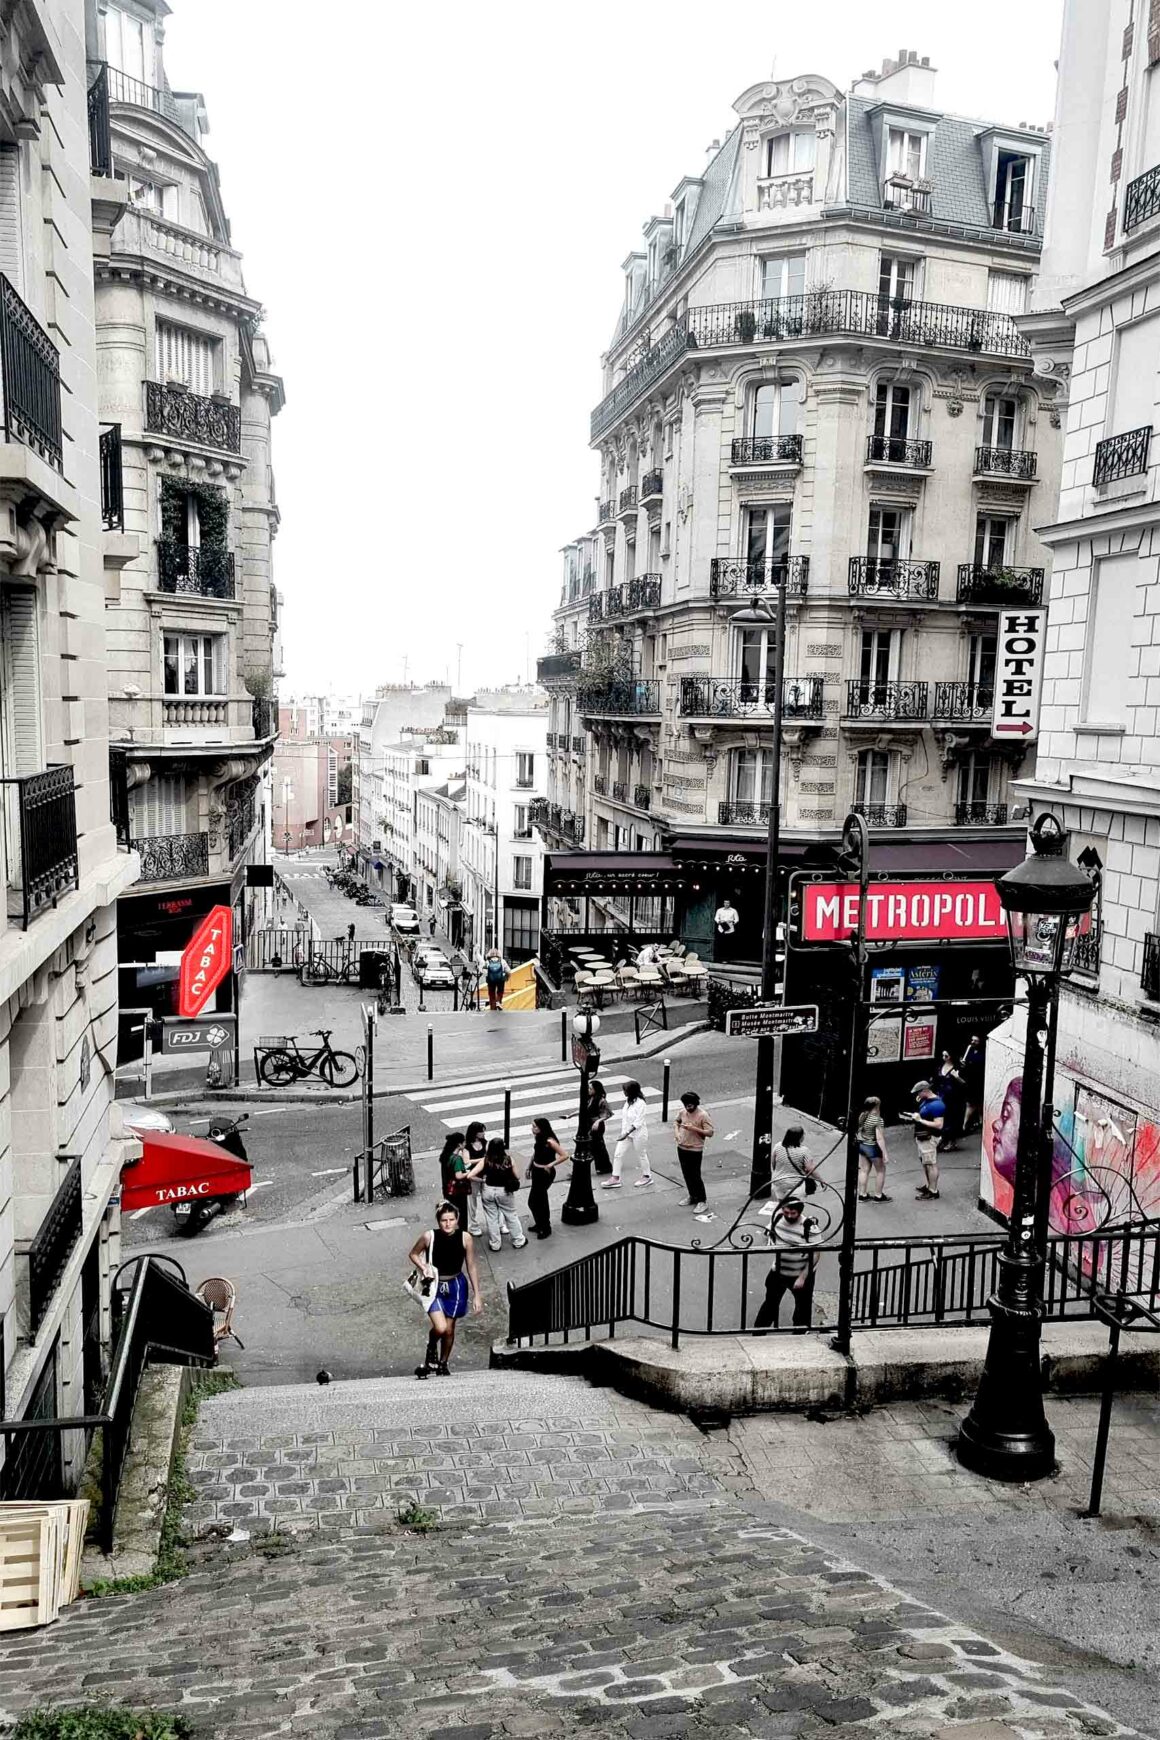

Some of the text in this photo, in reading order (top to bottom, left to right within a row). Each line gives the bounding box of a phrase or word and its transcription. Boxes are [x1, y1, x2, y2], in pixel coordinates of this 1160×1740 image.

[1000, 615, 1040, 718] HOTEL
[191, 928, 222, 995] TABAC
[956, 1015, 978, 1024] LOUIS
[172, 1031, 201, 1044] FDJ
[155, 1182, 210, 1201] TABAC
